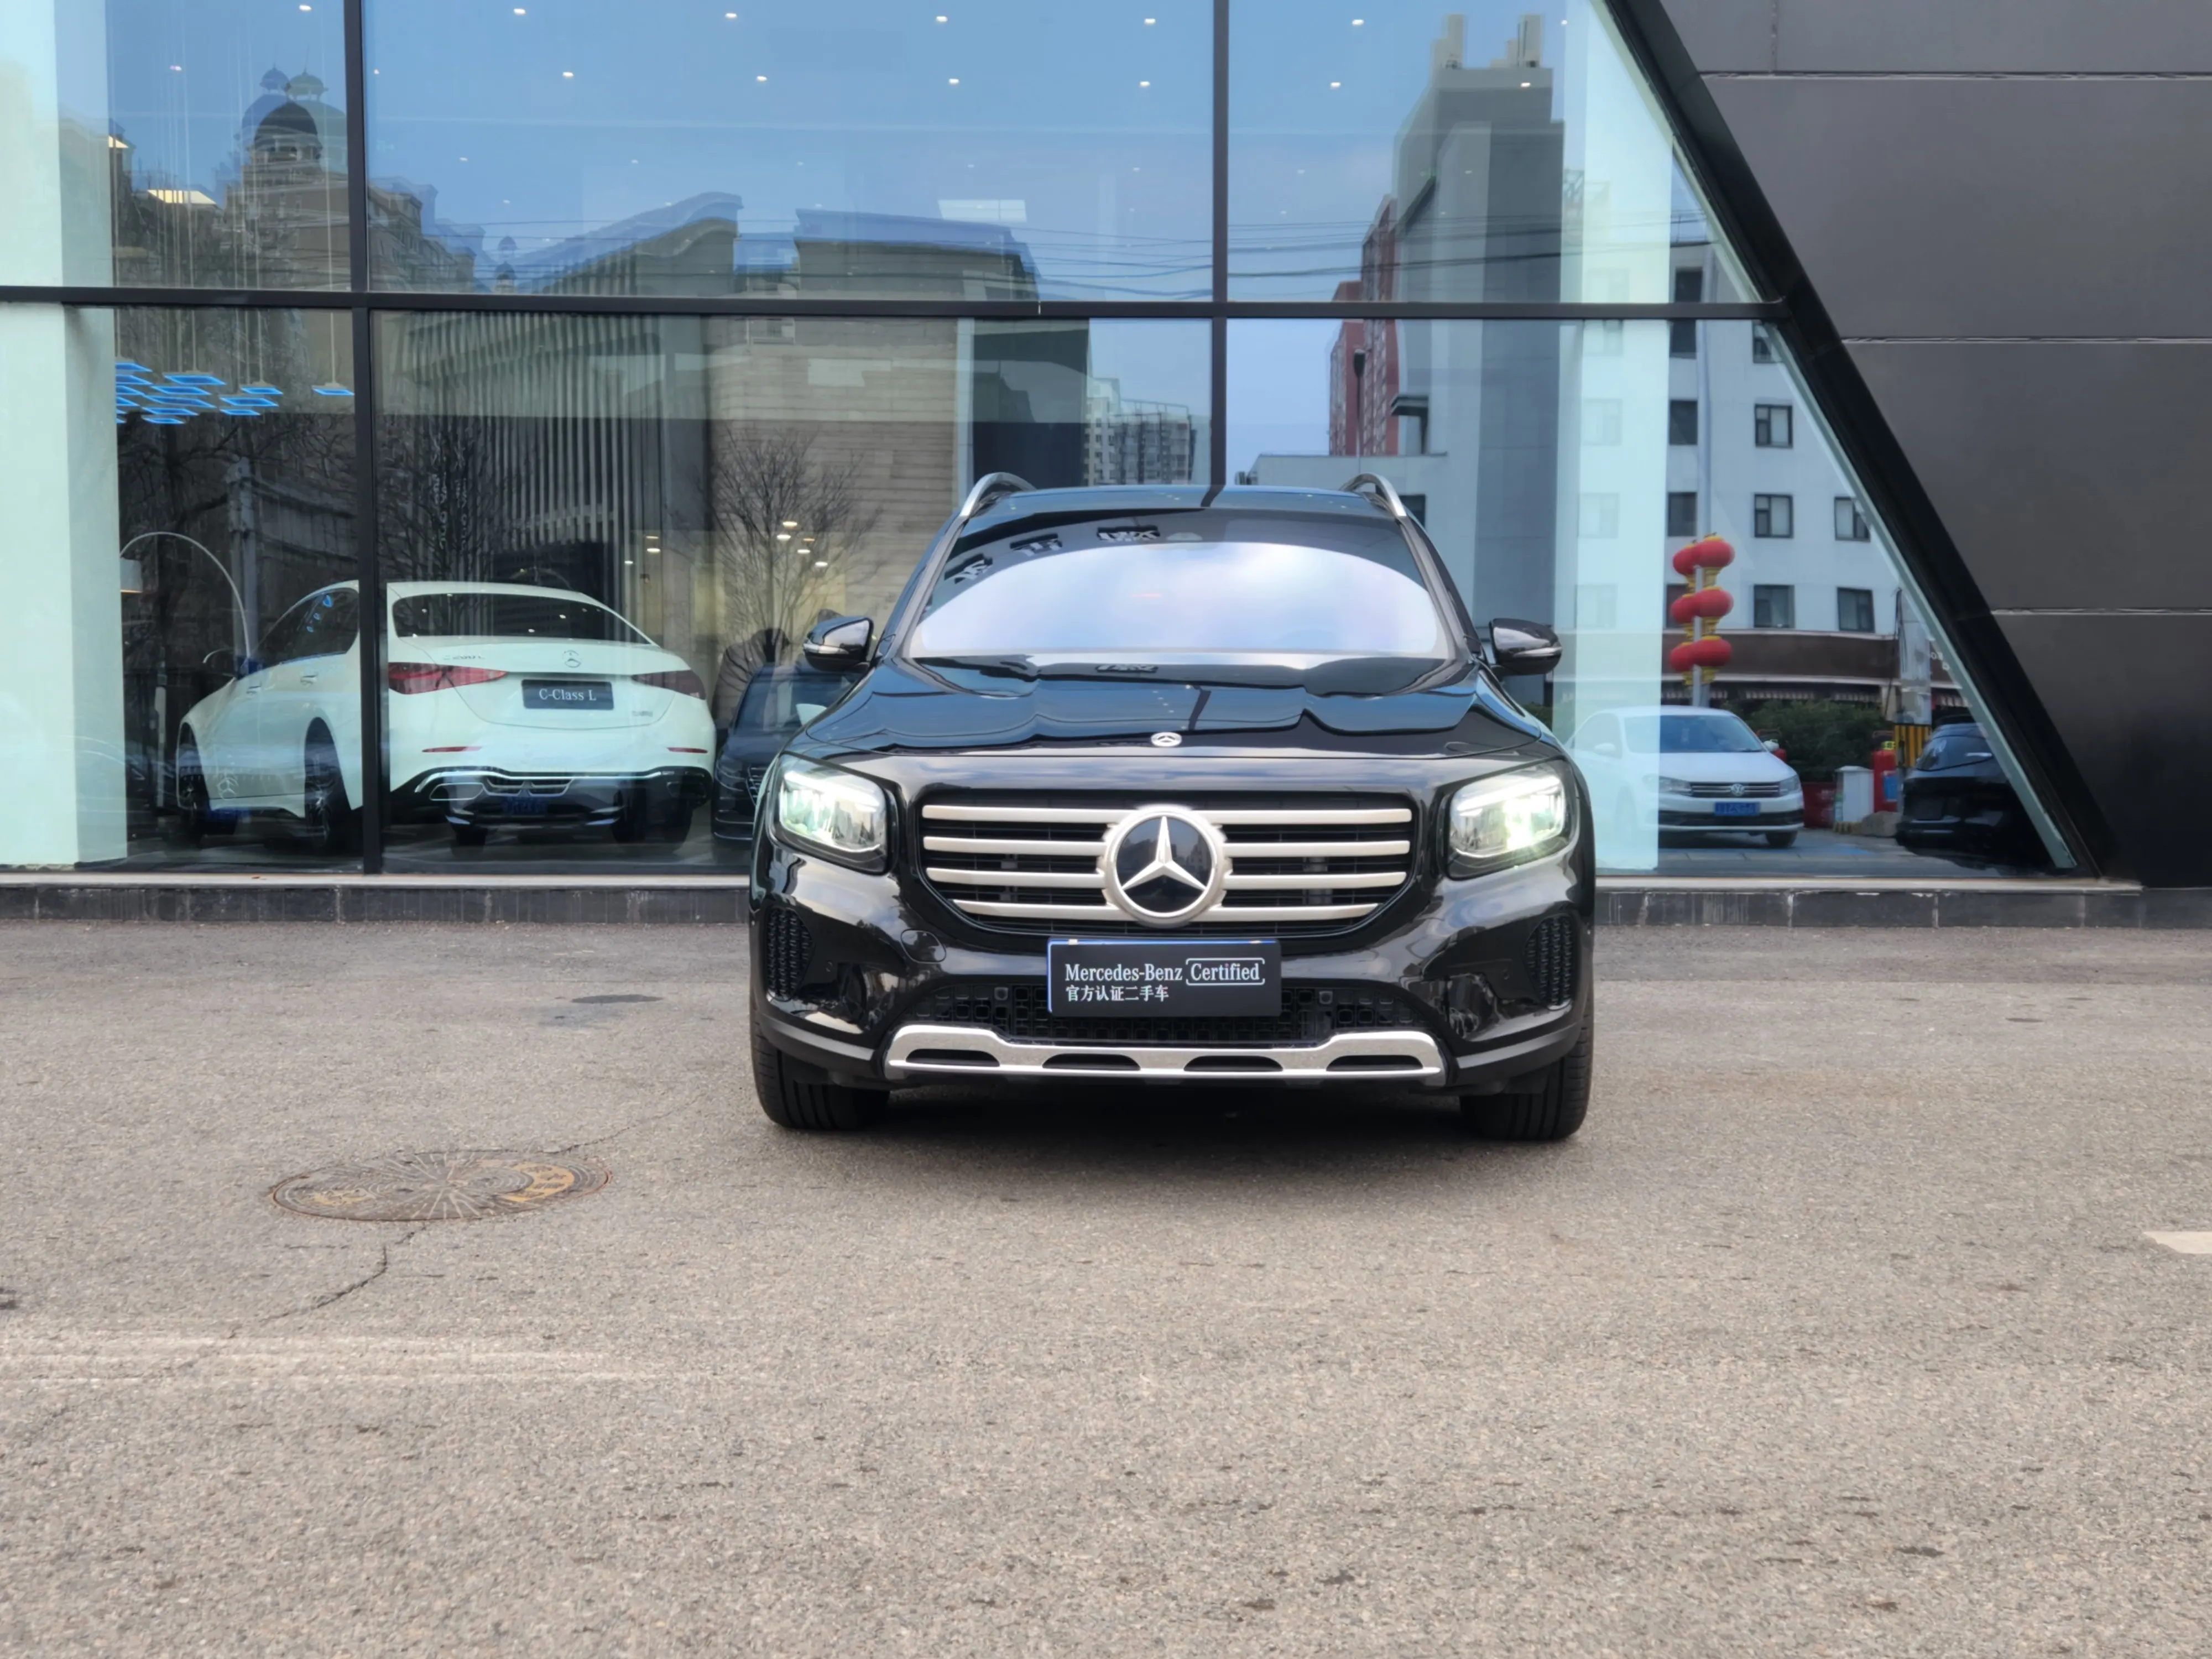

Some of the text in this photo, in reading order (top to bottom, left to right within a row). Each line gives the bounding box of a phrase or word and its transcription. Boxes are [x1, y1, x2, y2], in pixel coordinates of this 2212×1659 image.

[539, 688, 597, 701] C-Class L
[1065, 962, 1260, 981] Mercedes-Benz Certified
[1066, 985, 1169, 1001] 官方认证二手车
